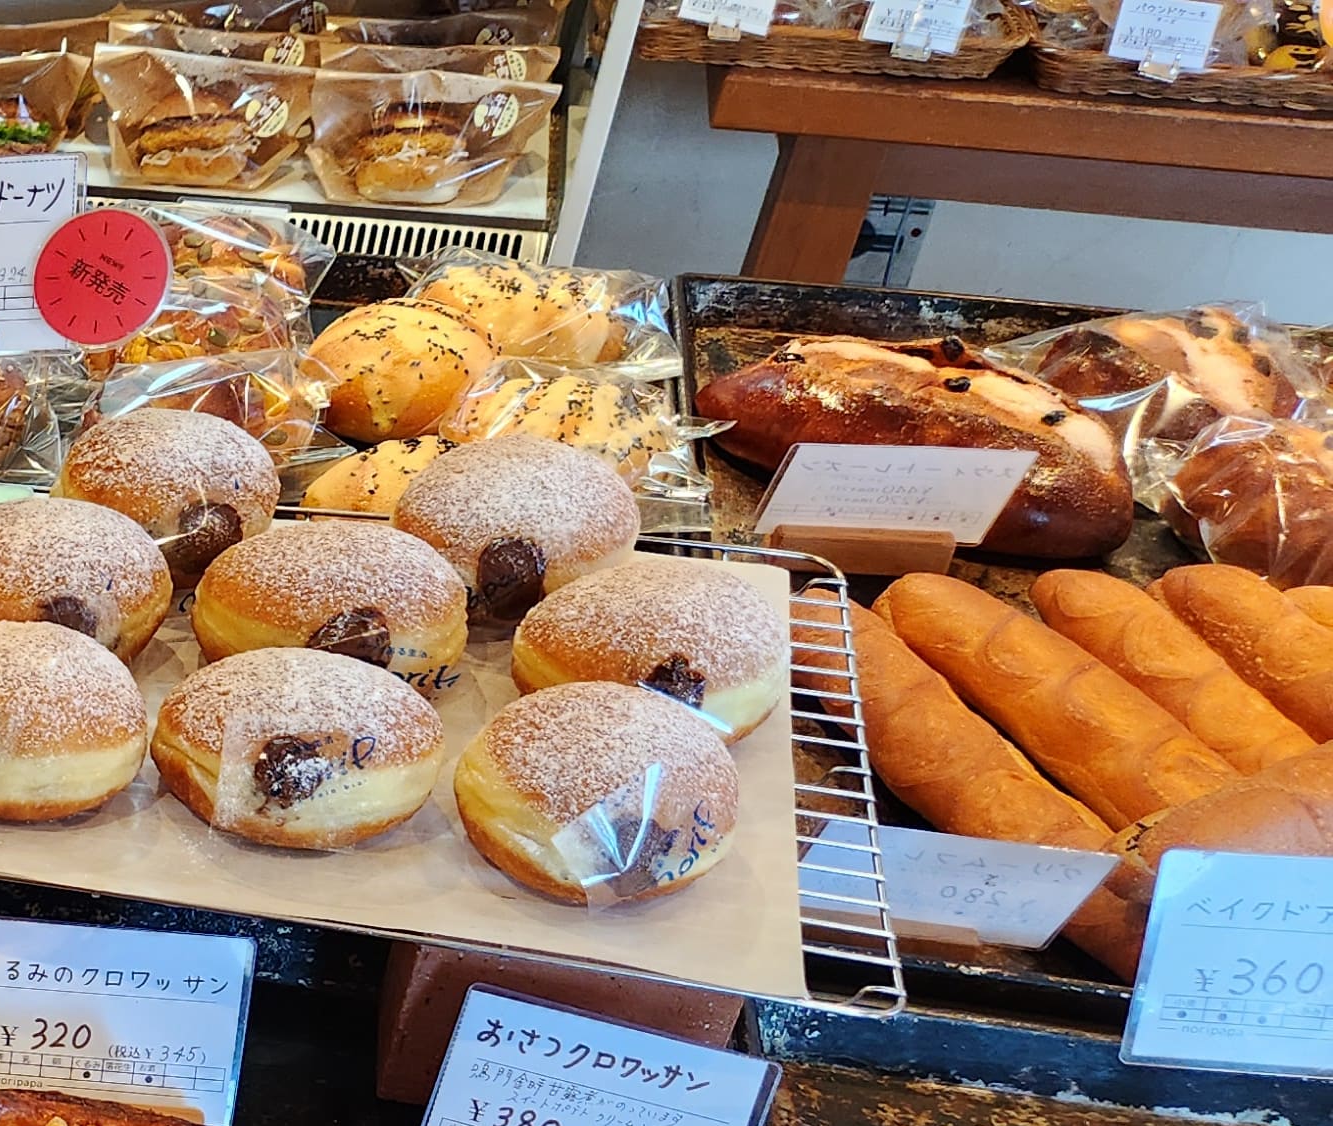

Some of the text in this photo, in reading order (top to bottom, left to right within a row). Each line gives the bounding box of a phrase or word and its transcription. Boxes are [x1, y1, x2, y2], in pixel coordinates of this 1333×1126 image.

[68, 258, 131, 305] 新発売
[1194, 958, 1325, 996] ¥360
[0, 1018, 92, 1050] ¥320
[477, 1018, 710, 1091] おさつクロワッサン
